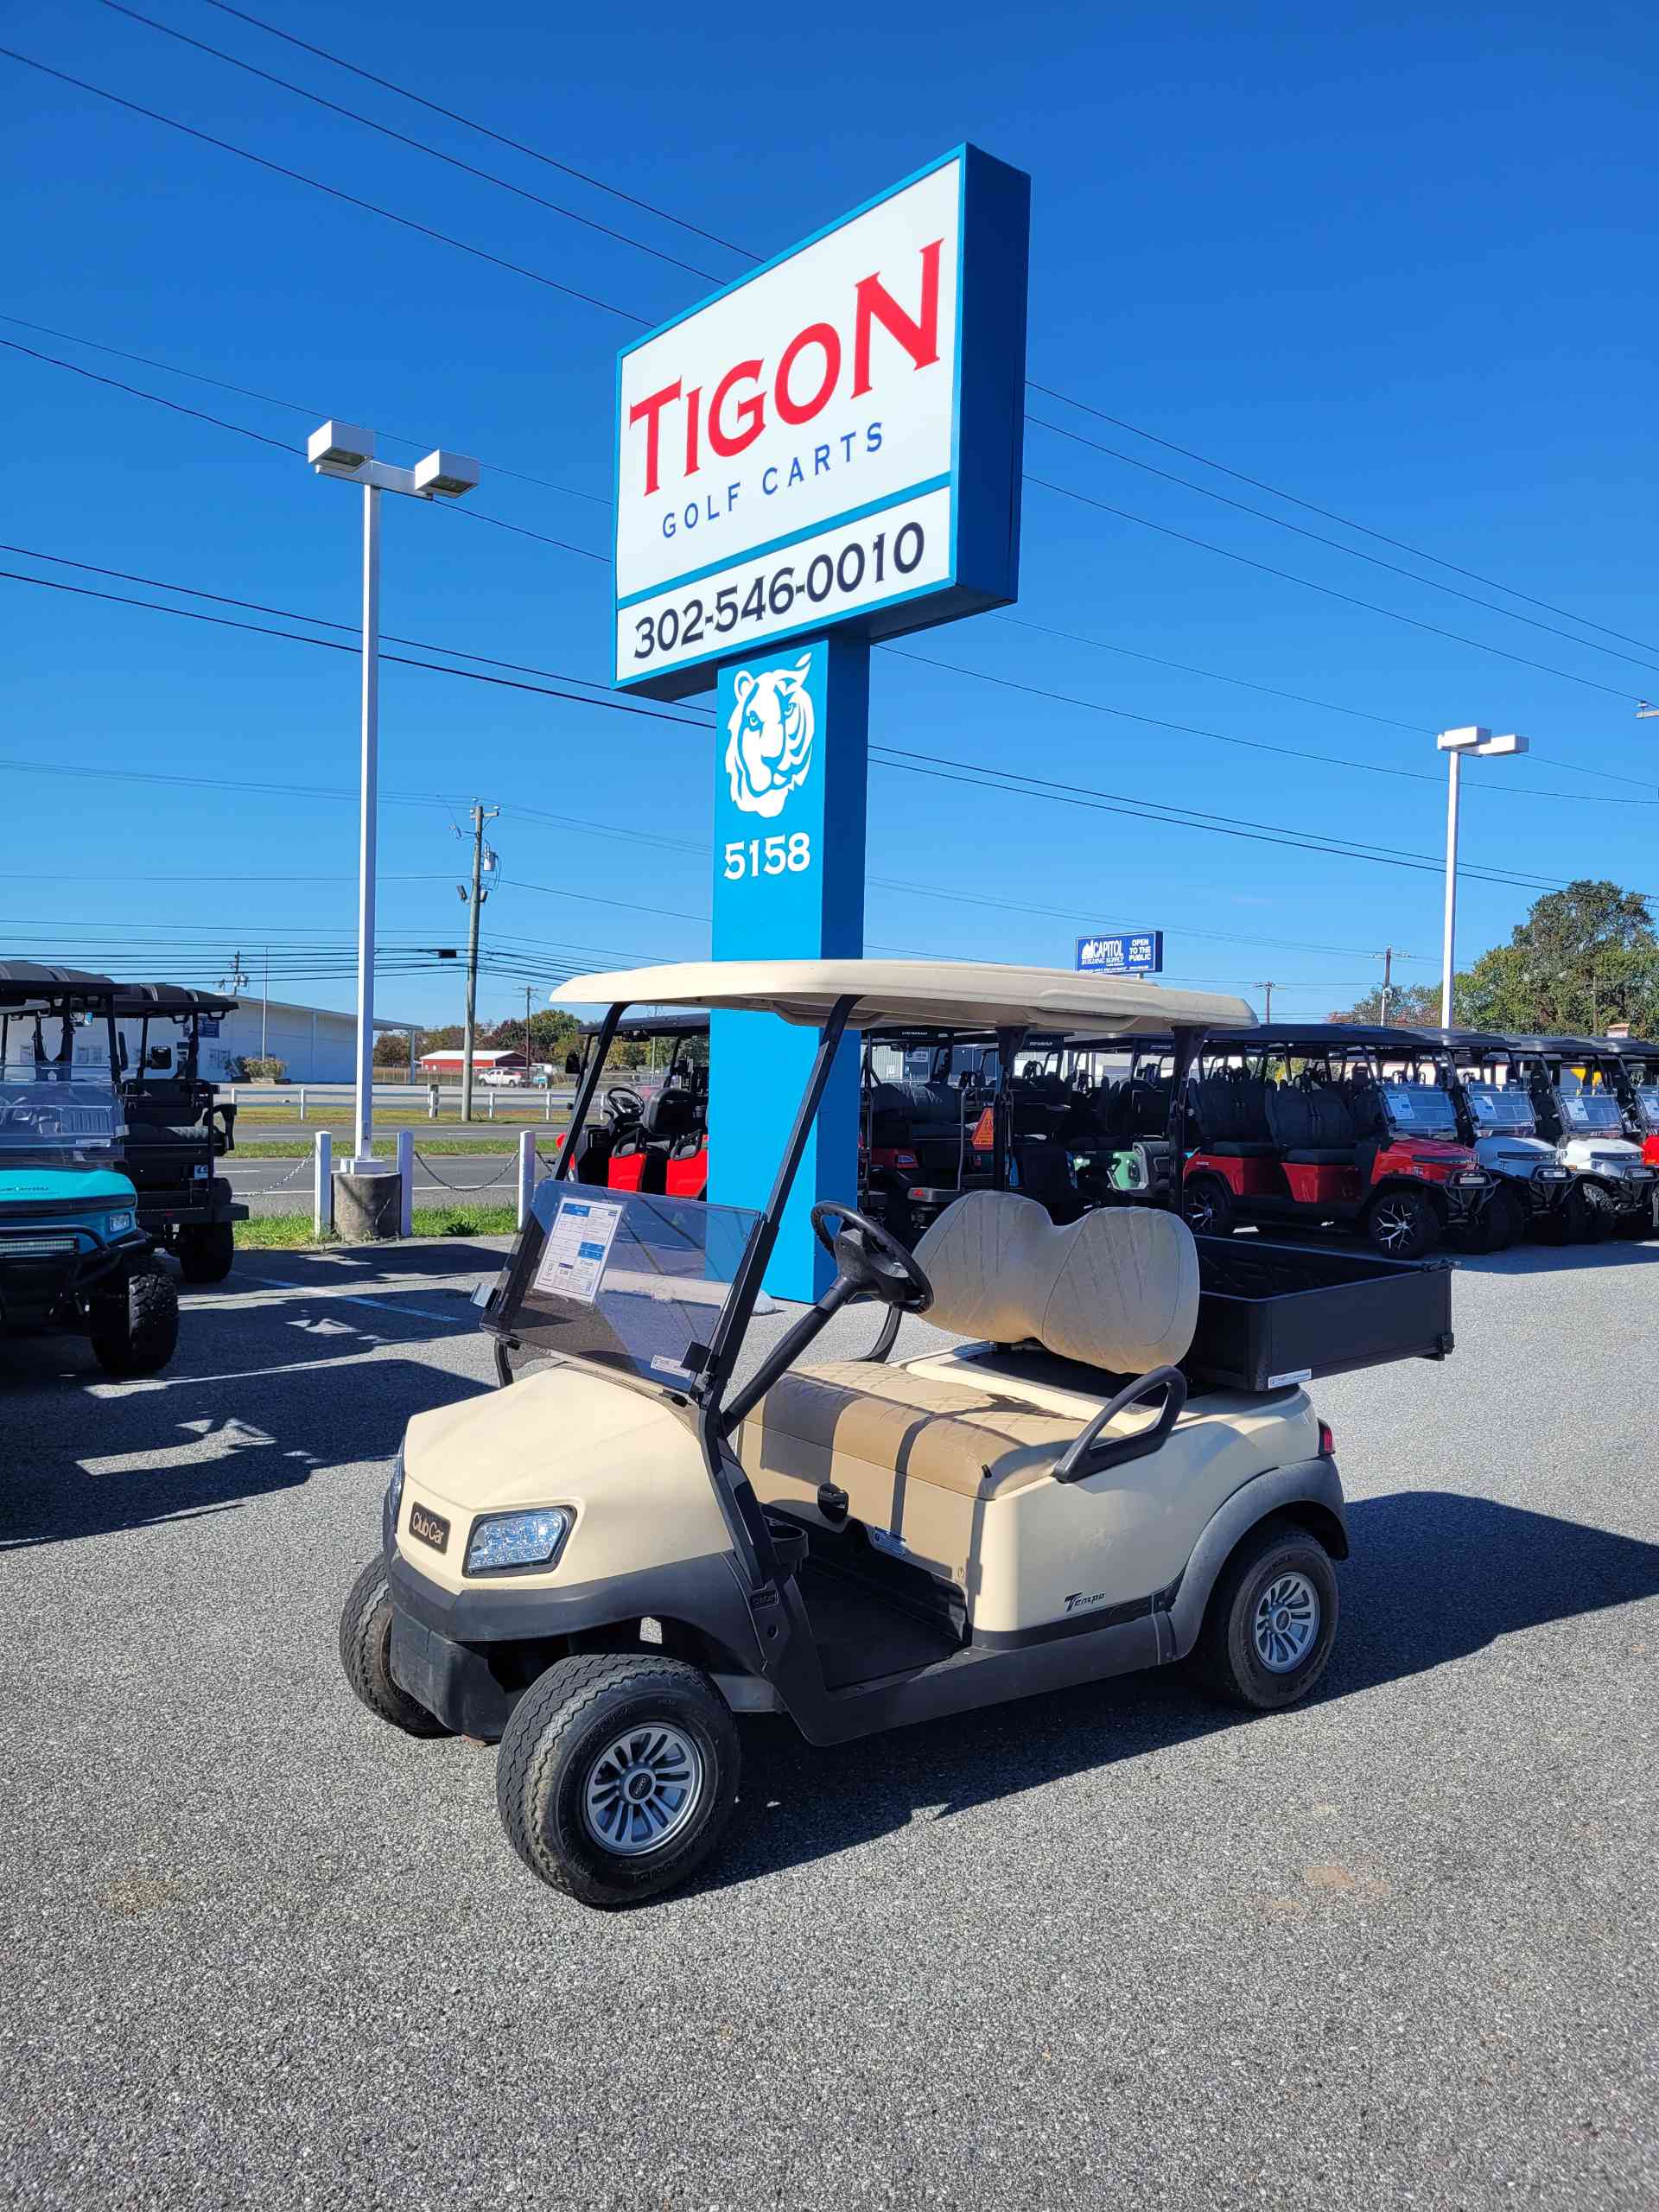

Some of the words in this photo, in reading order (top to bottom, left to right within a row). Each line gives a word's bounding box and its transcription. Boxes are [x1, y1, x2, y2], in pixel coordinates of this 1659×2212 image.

[630, 238, 945, 497] TIGON
[662, 480, 741, 539] GOLF
[762, 422, 883, 496] CARTS
[633, 520, 925, 660] 302-546-0010
[724, 832, 810, 880] 5158
[1094, 940, 1123, 957] CAPITOL
[412, 1512, 429, 1537] Club
[429, 1522, 444, 1545] Car
